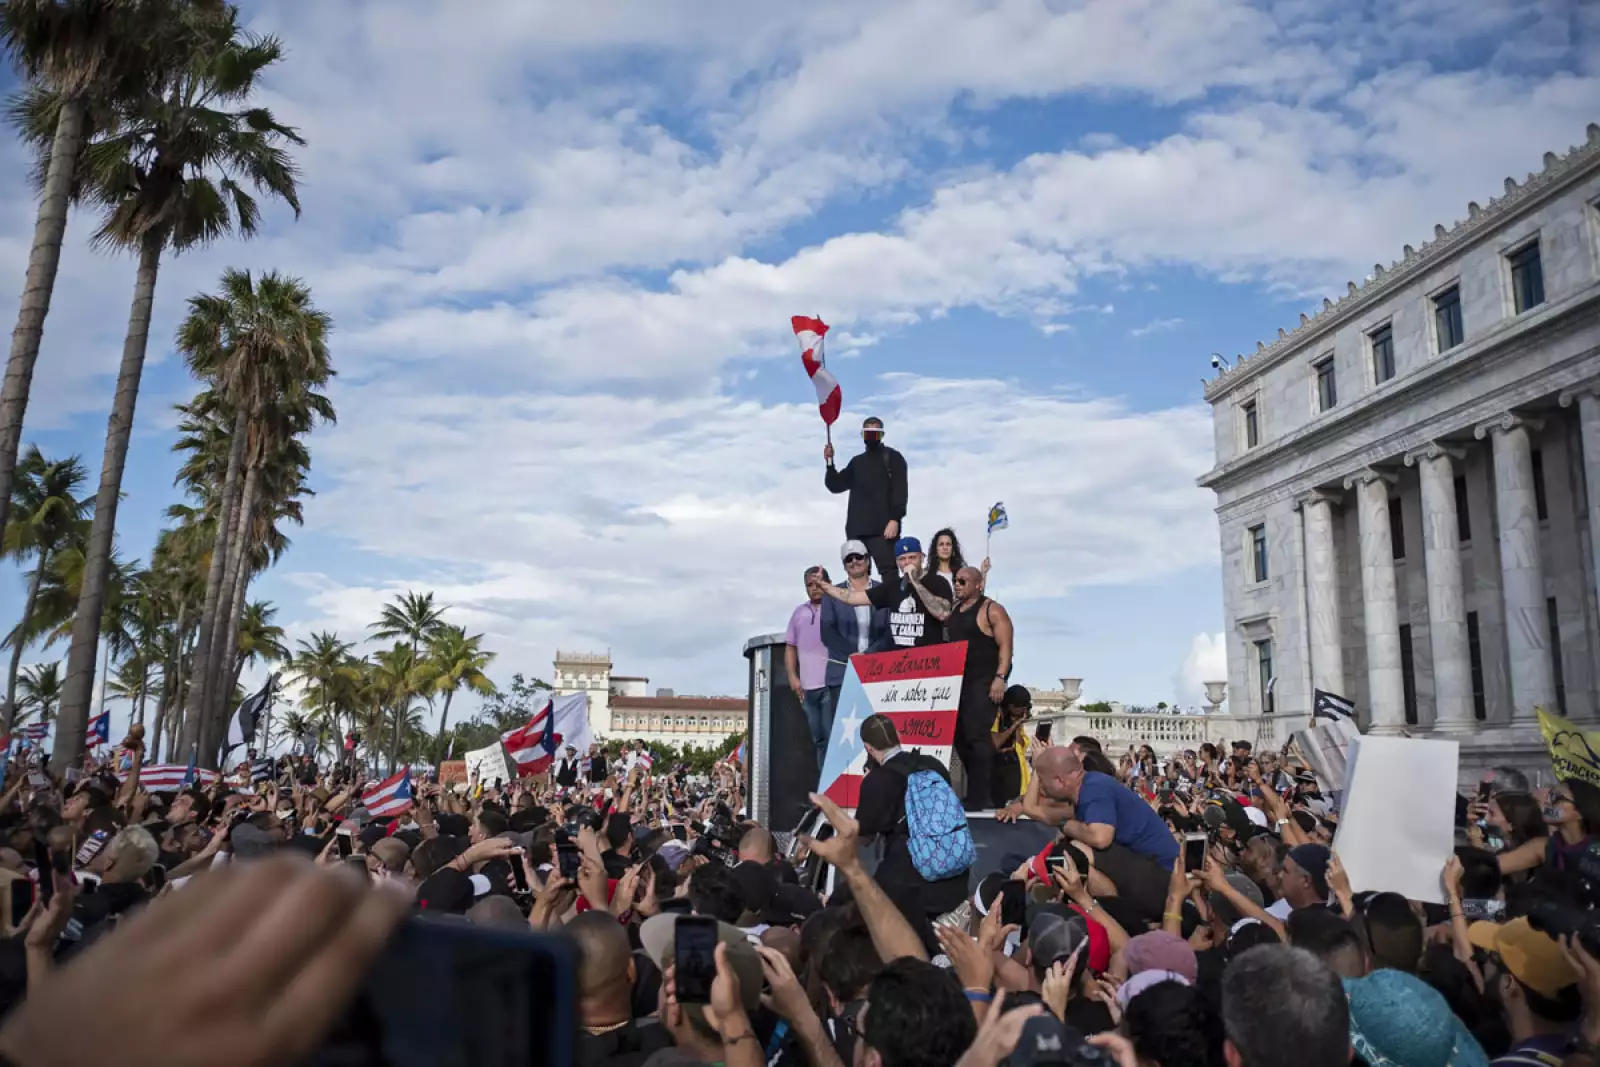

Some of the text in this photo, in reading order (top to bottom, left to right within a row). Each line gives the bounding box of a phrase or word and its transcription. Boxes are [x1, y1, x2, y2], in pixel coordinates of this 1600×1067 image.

[881, 680, 951, 710] sin saber que
